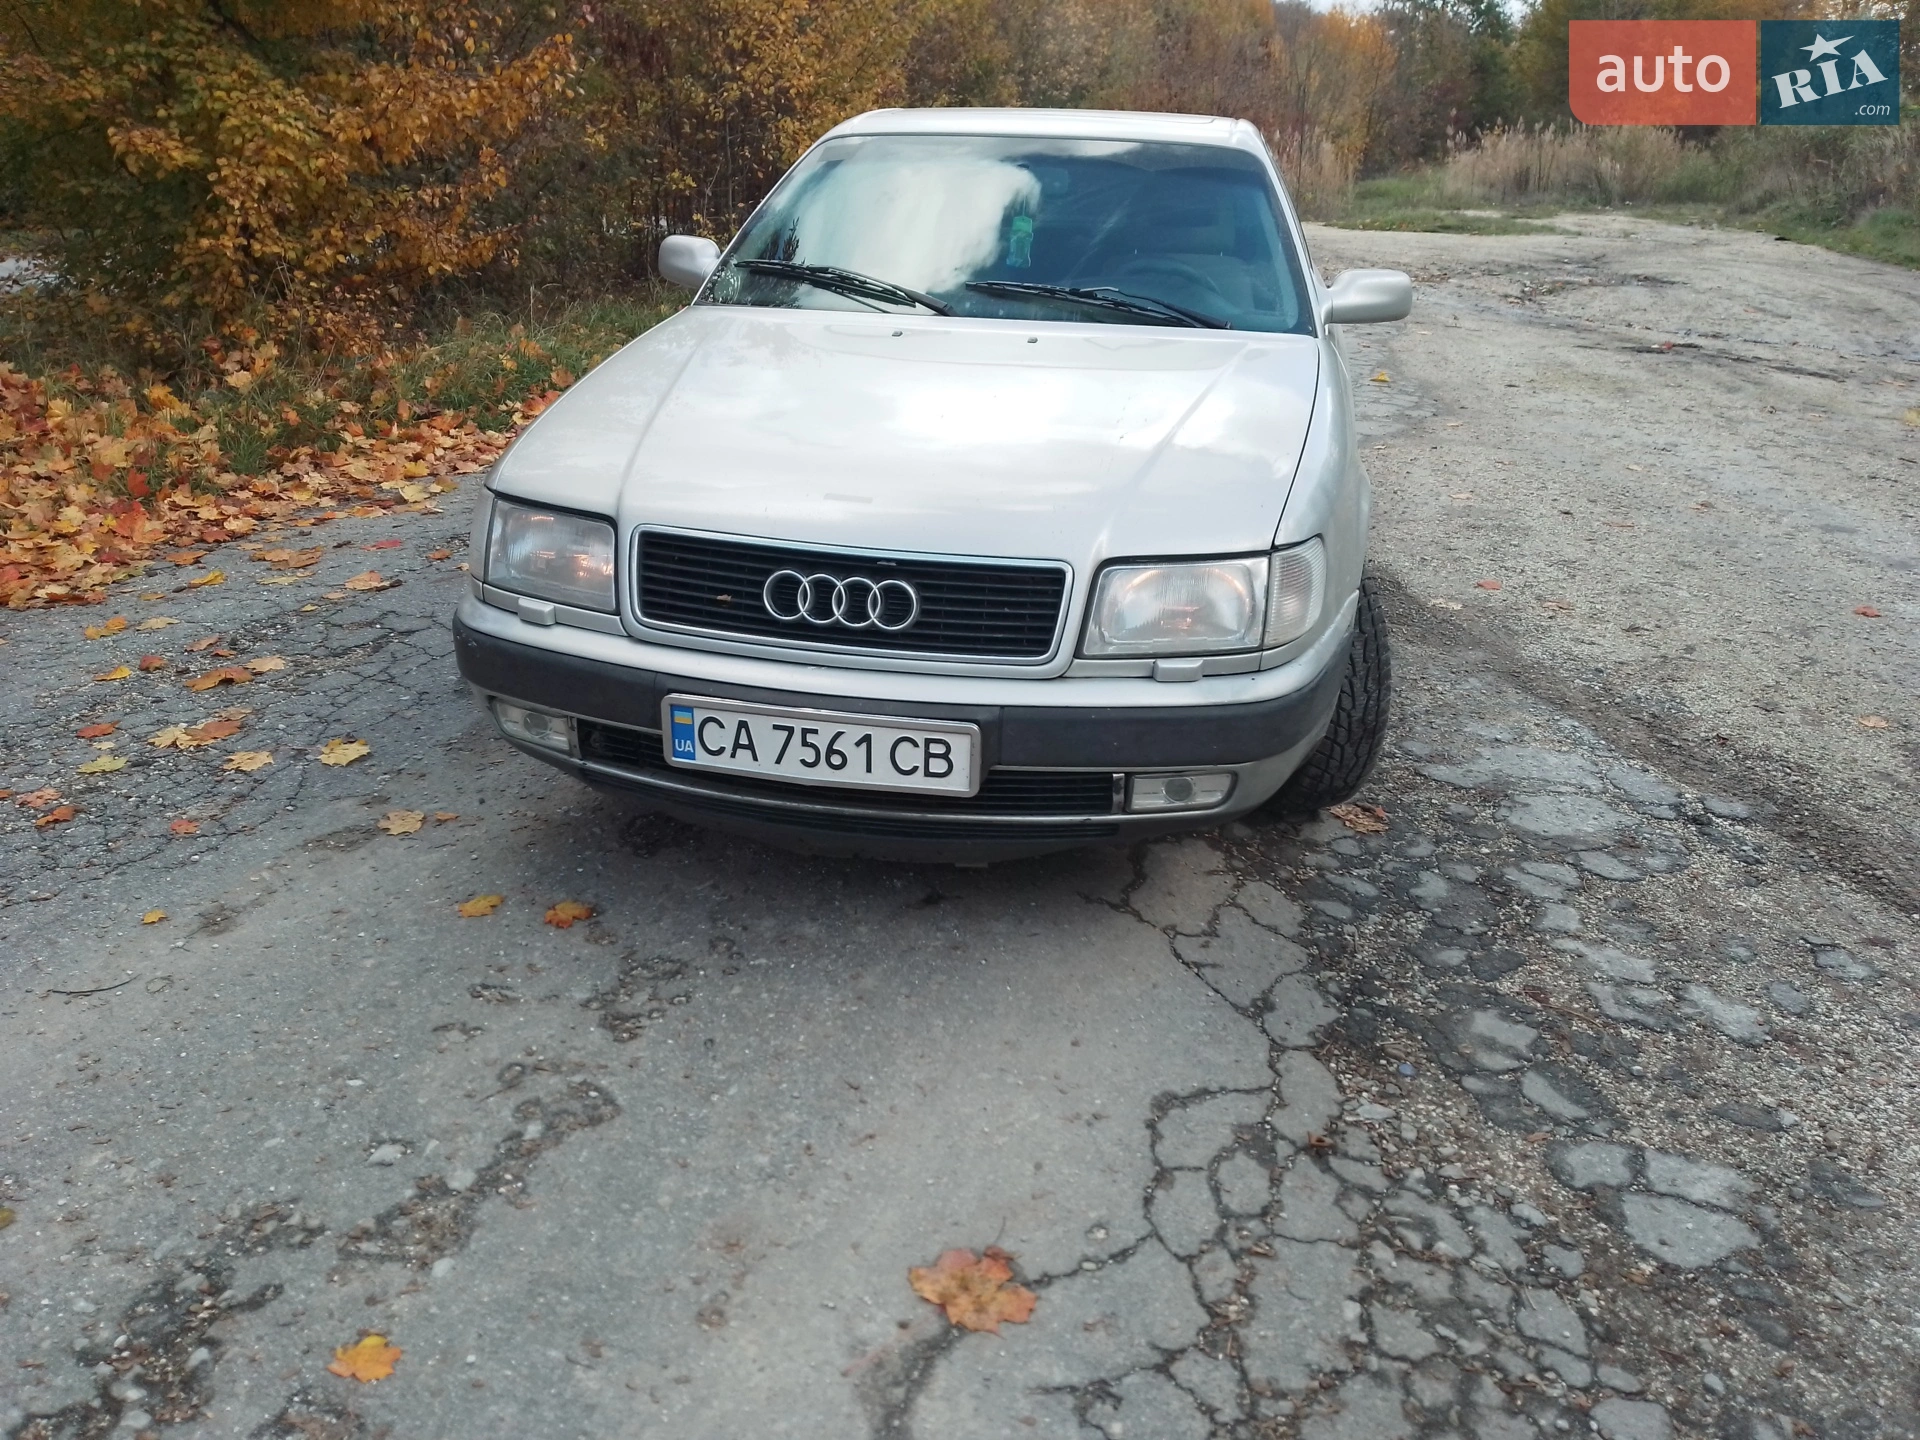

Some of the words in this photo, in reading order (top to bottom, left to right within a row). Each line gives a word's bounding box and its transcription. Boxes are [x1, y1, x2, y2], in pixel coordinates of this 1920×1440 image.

[675, 739, 694, 753] UA
[697, 716, 759, 762] CA
[772, 724, 873, 773] 7561
[889, 735, 954, 778] CB
